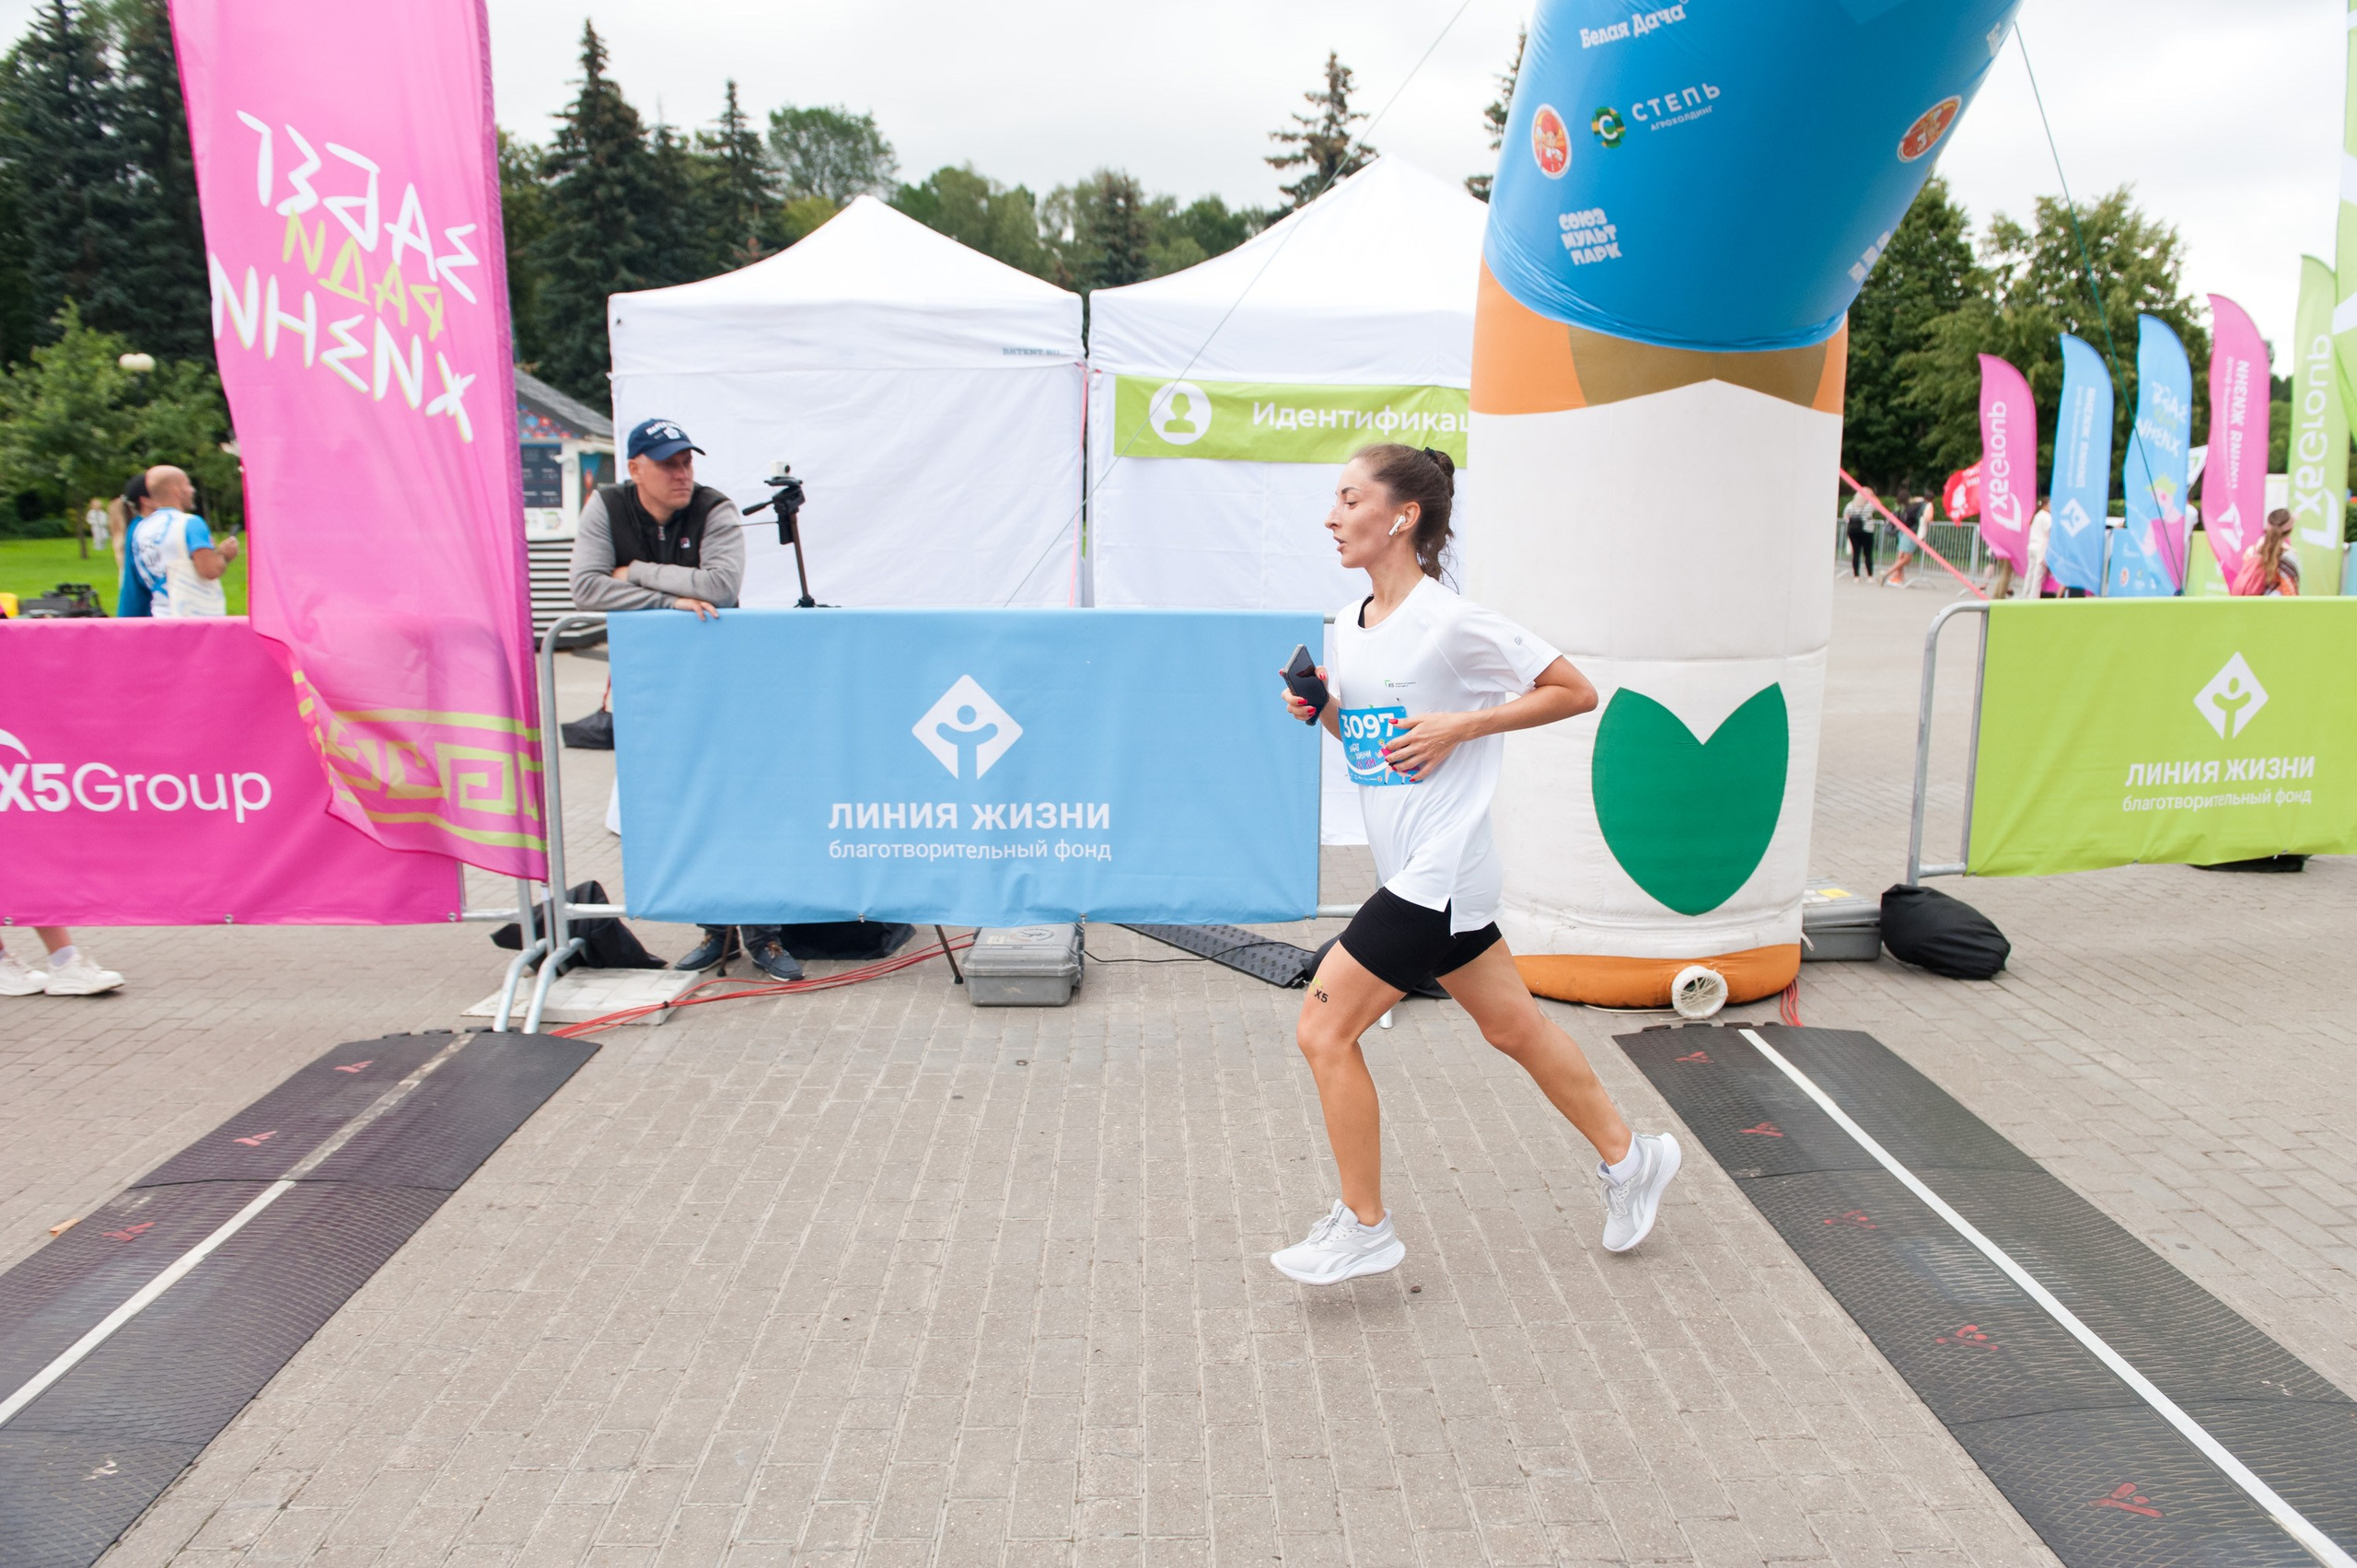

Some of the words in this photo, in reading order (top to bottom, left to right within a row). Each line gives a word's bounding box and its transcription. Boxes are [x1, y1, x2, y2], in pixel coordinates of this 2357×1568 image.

[1579, 21, 1630, 49] Белая
[1631, 5, 1687, 37] Дача
[1631, 83, 1721, 122] СТЕПЬ
[1651, 105, 1713, 131] АГРОХОЛДИНГ
[1559, 207, 1608, 231] СОЮЗ
[1561, 224, 1618, 250] МУЛЬТ
[1571, 241, 1622, 265] ПАРК
[1341, 713, 1395, 738] 3097
[2125, 761, 2218, 787] ЛИНИЯ
[2224, 756, 2316, 782] ЖИЗНИ
[0, 762, 272, 823] X5Group
[2122, 788, 2271, 813] благотворительный
[2274, 786, 2312, 808] фонд
[829, 803, 958, 829] ЛИНИЯ
[971, 803, 1110, 830] ЖИЗНИ
[829, 839, 1048, 861] благотворительный
[1053, 840, 1112, 861] фонд
[1315, 989, 1329, 1003] X5
